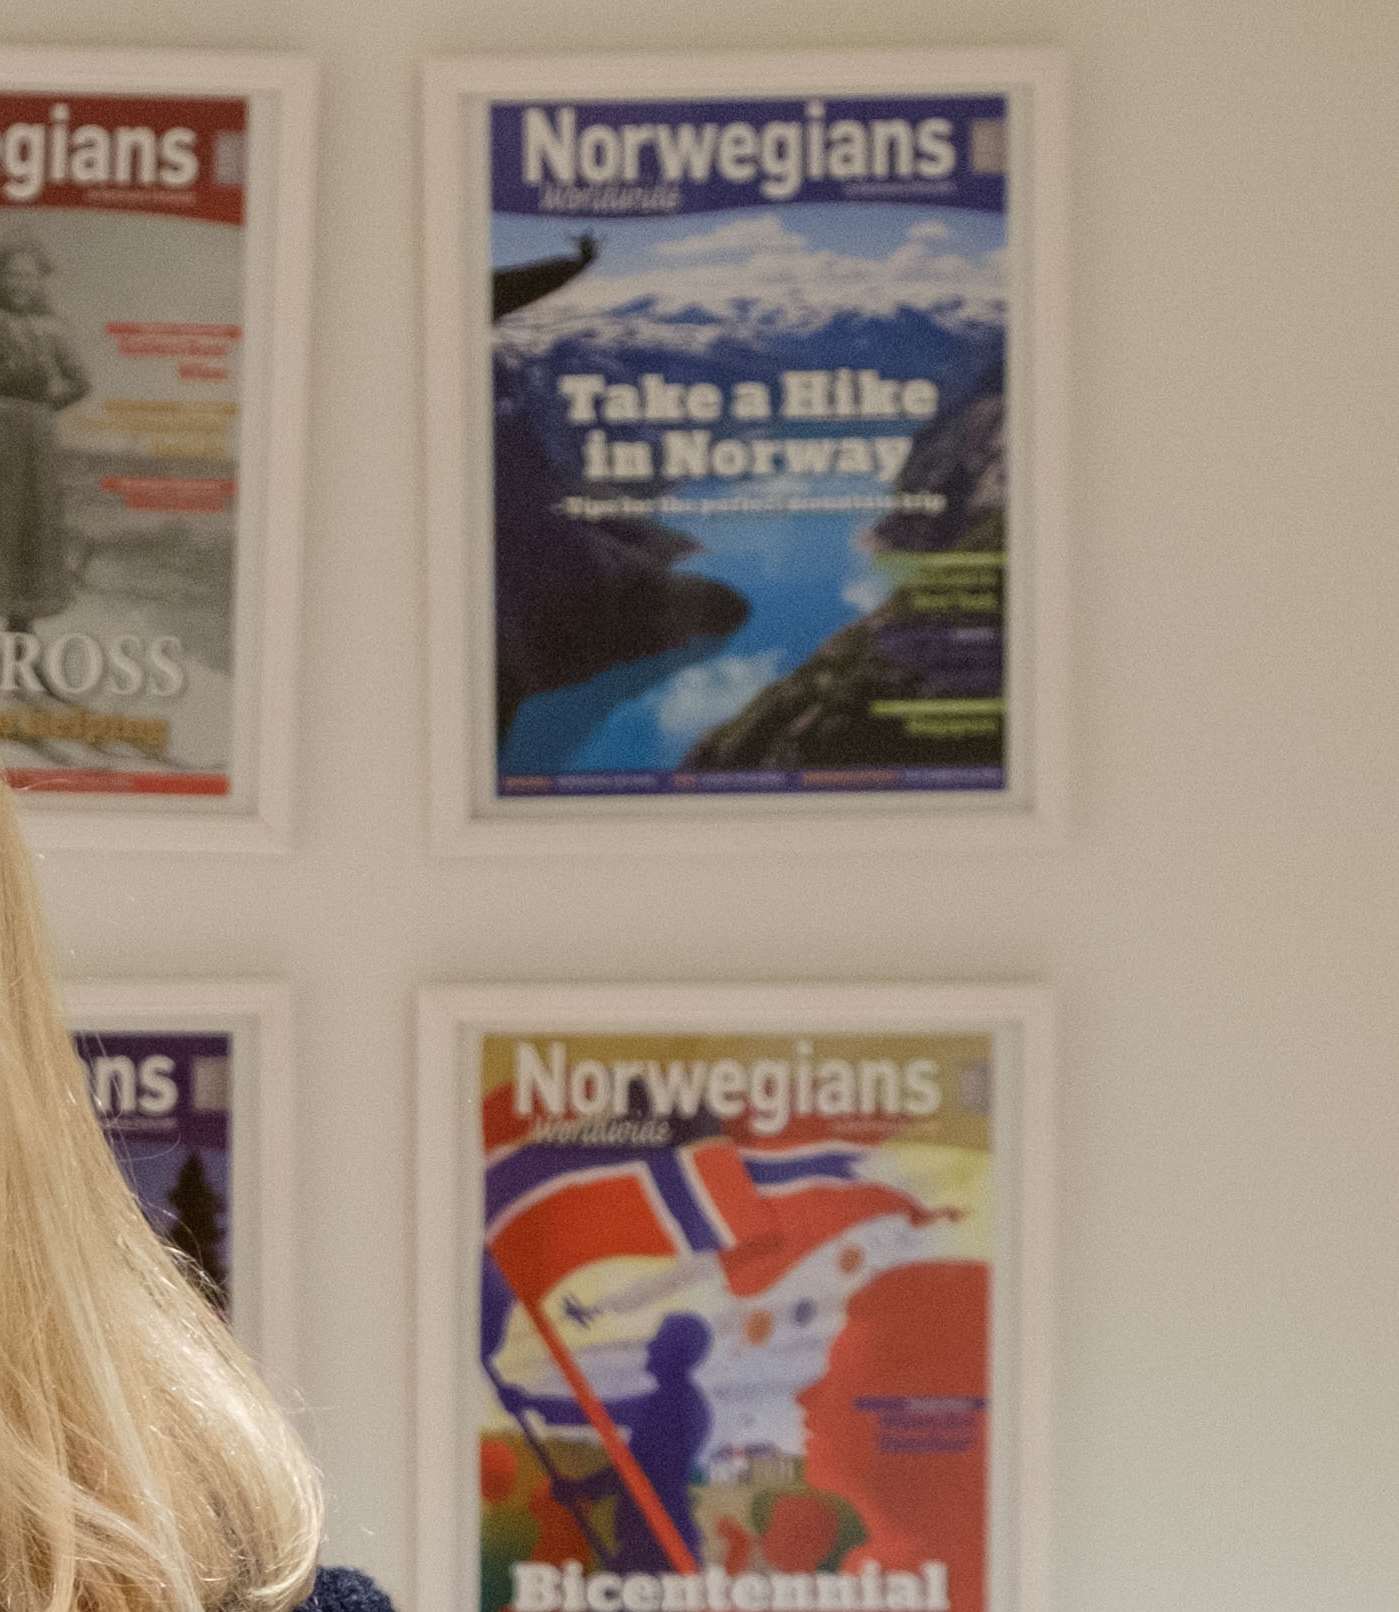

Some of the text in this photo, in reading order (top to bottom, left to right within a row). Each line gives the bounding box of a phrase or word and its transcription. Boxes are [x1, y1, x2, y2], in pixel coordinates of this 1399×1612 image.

[523, 101, 956, 199] Norwegians
[559, 369, 938, 423] Take a Hike
[584, 428, 914, 483] in Norway
[514, 1039, 941, 1136] Norwegians
